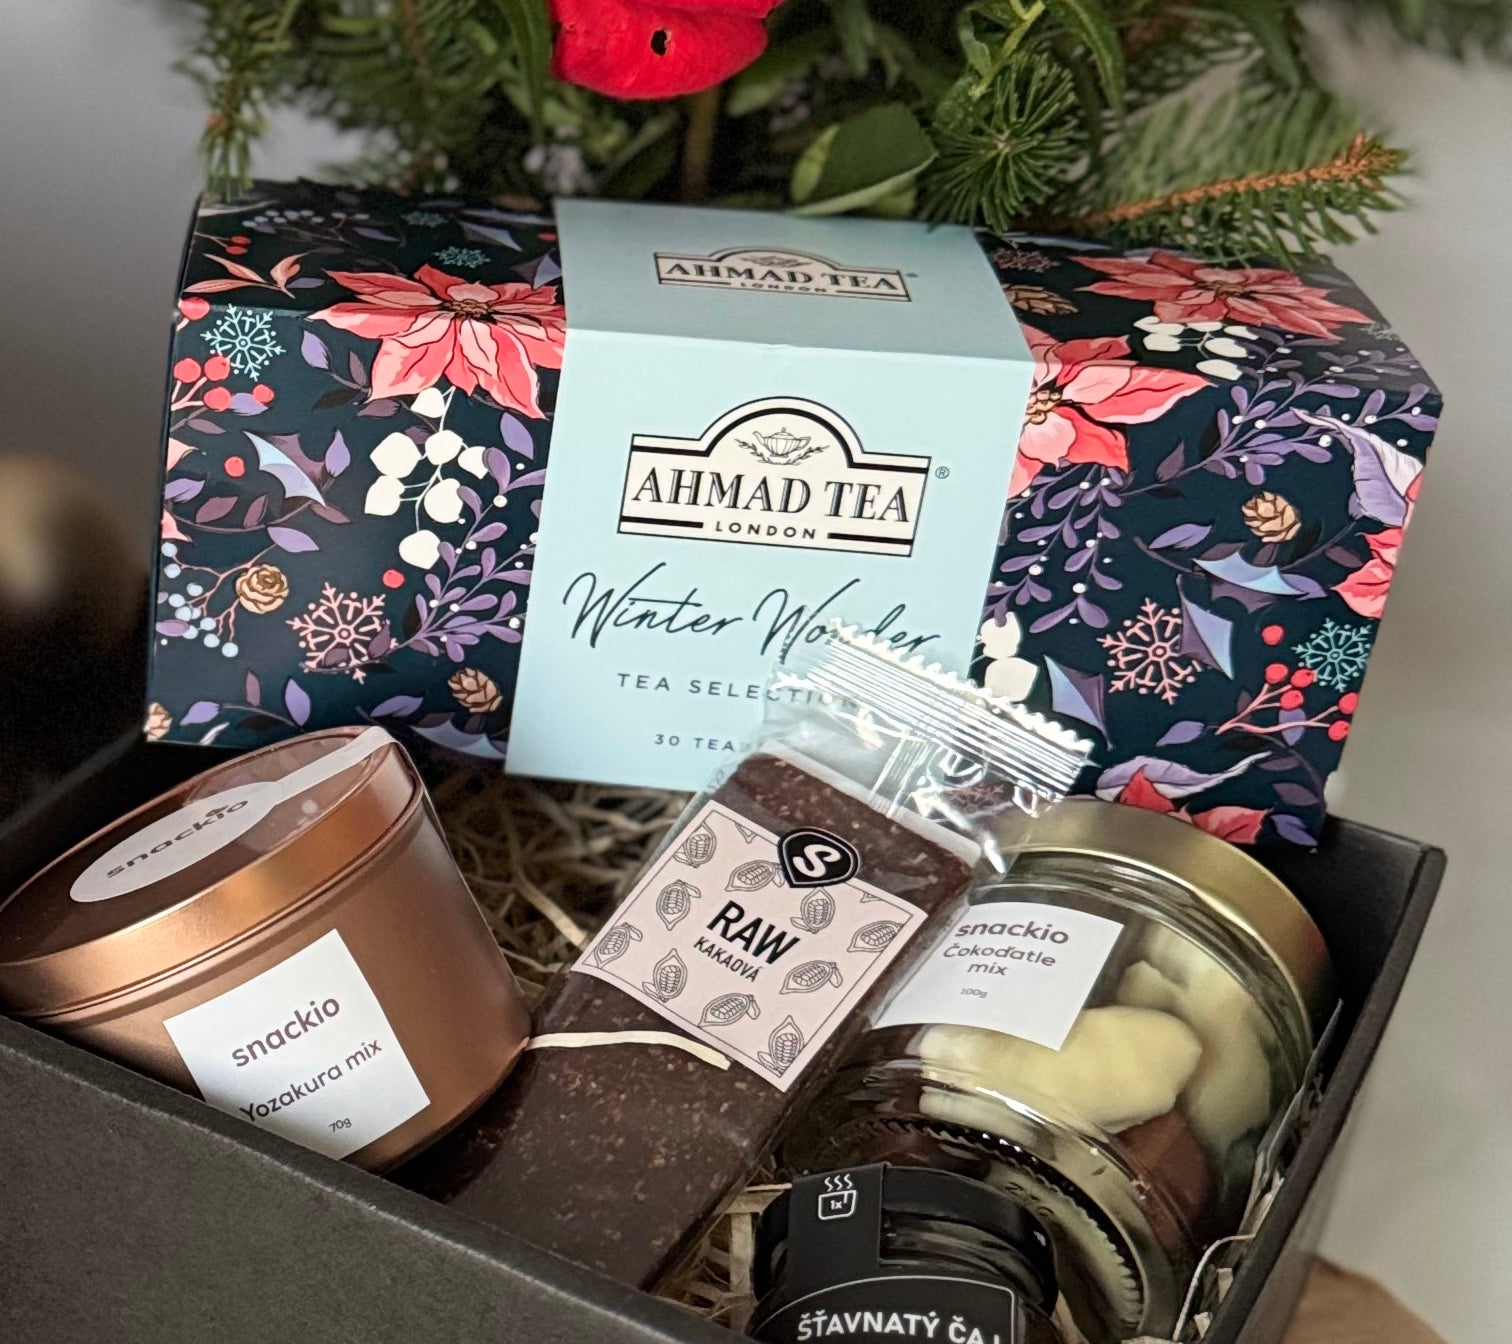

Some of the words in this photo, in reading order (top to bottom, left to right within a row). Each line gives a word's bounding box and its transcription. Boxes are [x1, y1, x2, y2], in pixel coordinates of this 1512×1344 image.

[665, 263, 813, 285] AHMAD
[821, 272, 899, 291] TEA
[740, 282, 827, 294] LONDON
[631, 466, 812, 514] AHMAD
[825, 480, 910, 524] TEA
[715, 520, 817, 541] LONDON
[562, 561, 744, 649] Winter
[751, 577, 942, 665] Woder
[617, 672, 672, 692] TEA
[654, 733, 681, 747] 30
[106, 800, 249, 879] snackio
[706, 899, 801, 966] RAW
[954, 920, 1070, 945] snackio
[693, 935, 764, 983] KAKAOVÁ
[966, 961, 1008, 976] mix
[959, 987, 988, 999] 100g
[231, 998, 341, 1068] snackio
[239, 1064, 343, 1122] Yozakura
[344, 1039, 383, 1071] mix
[327, 1117, 352, 1133] 70g
[796, 1309, 941, 1342] ŠŤAVNATÝ
